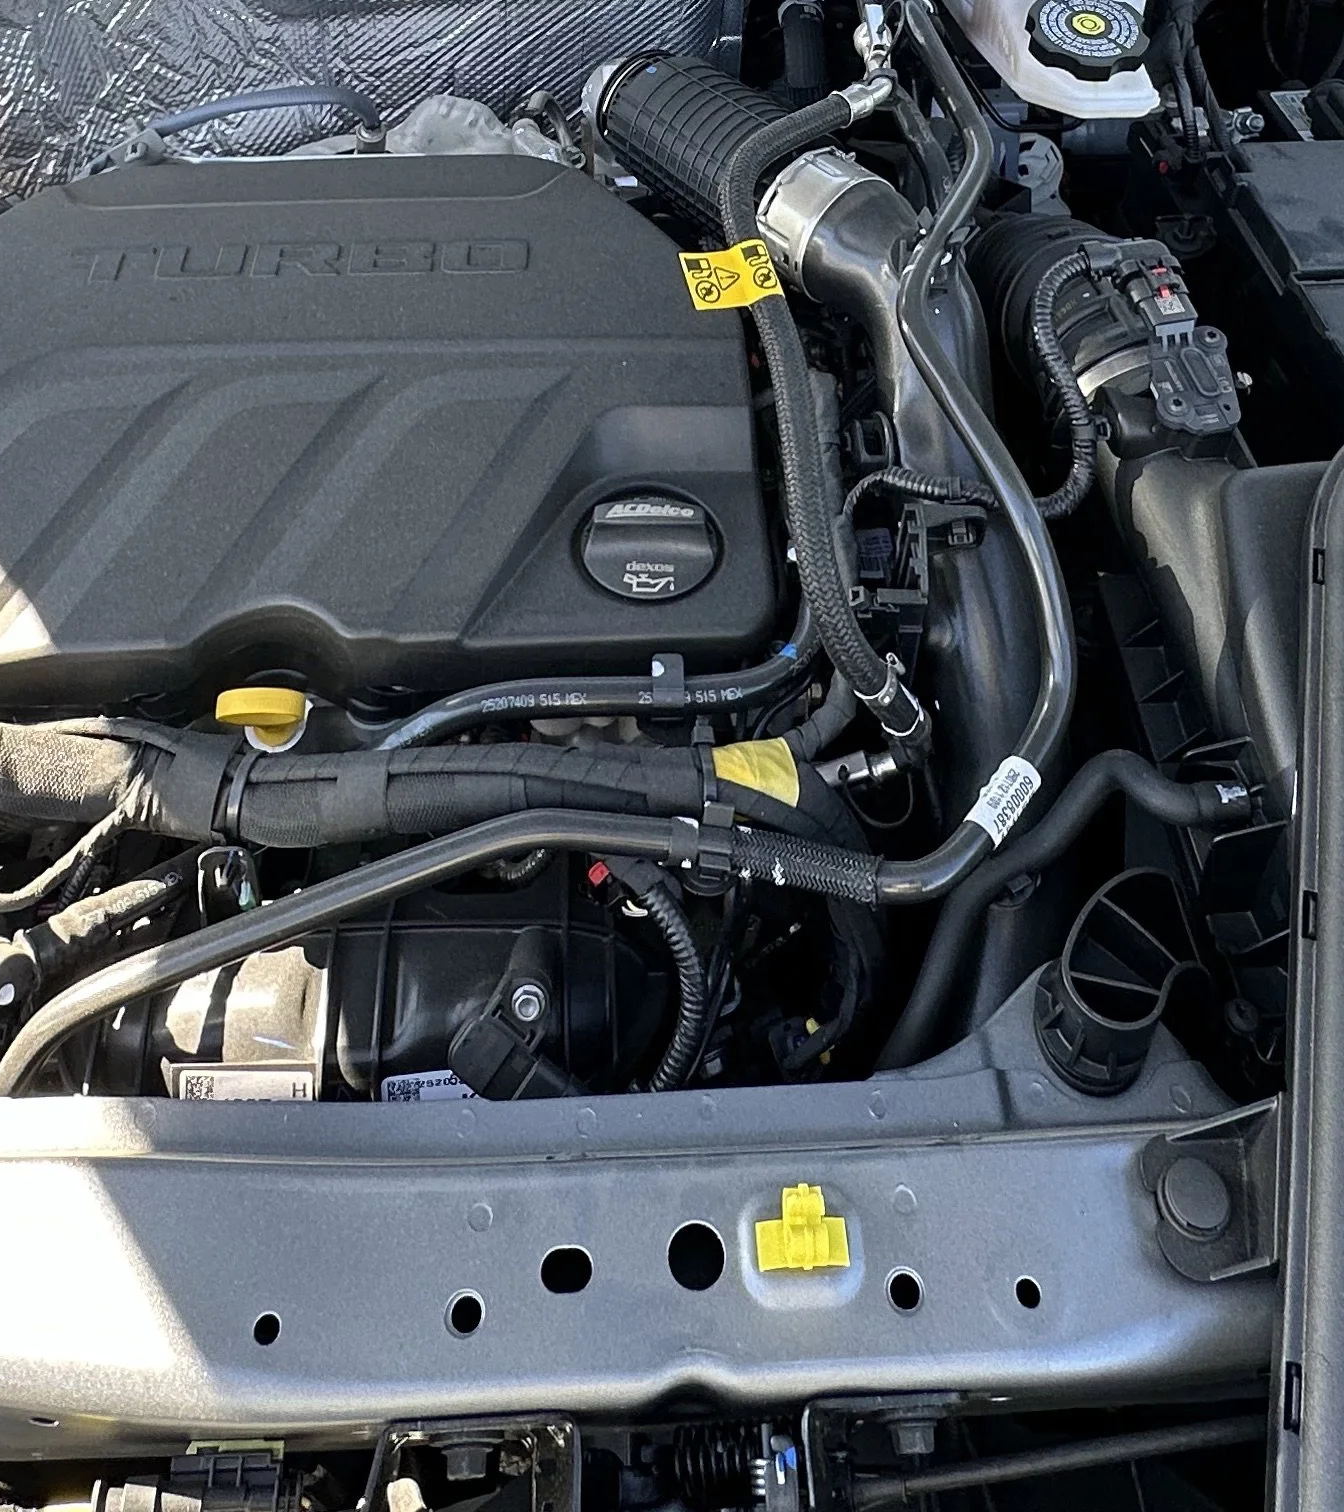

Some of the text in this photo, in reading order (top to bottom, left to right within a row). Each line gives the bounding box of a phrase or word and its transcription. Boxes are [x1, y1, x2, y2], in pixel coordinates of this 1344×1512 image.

[72, 238, 530, 282] TURBO
[605, 503, 694, 518] ACDelco
[626, 560, 674, 572] dexos
[539, 692, 560, 706] 515
[565, 692, 587, 705] MEX
[696, 690, 716, 703] 515
[720, 687, 744, 701] MEX
[292, 1082, 306, 1098] H
